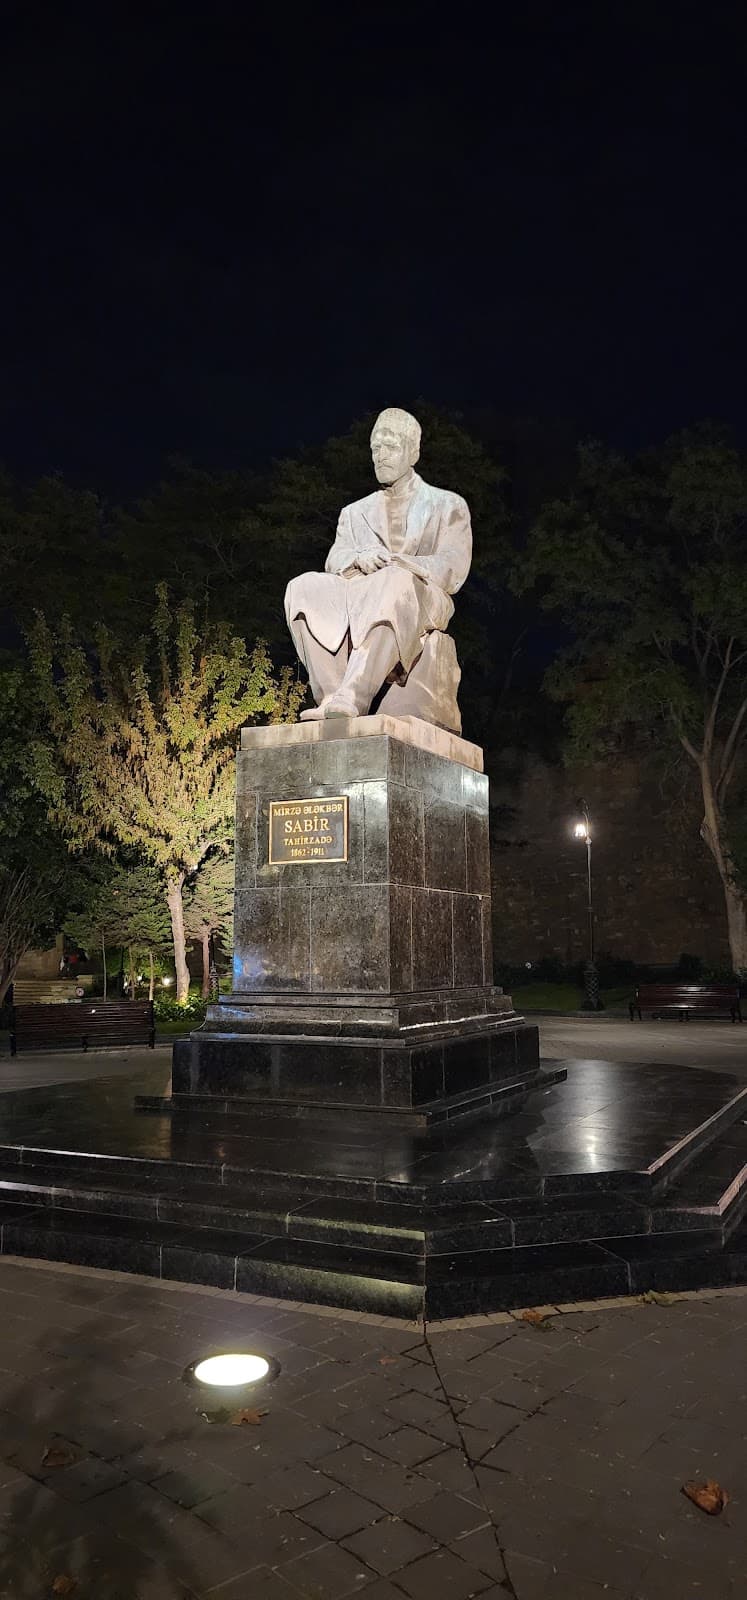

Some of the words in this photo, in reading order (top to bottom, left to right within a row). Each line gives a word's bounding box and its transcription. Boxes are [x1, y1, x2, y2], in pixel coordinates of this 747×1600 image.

[273, 807, 301, 816] MİRZƏ
[303, 804, 343, 814] ƏLƏKBƏR
[284, 816, 330, 833] SABİR
[284, 836, 332, 846] TAHİRZADƏ
